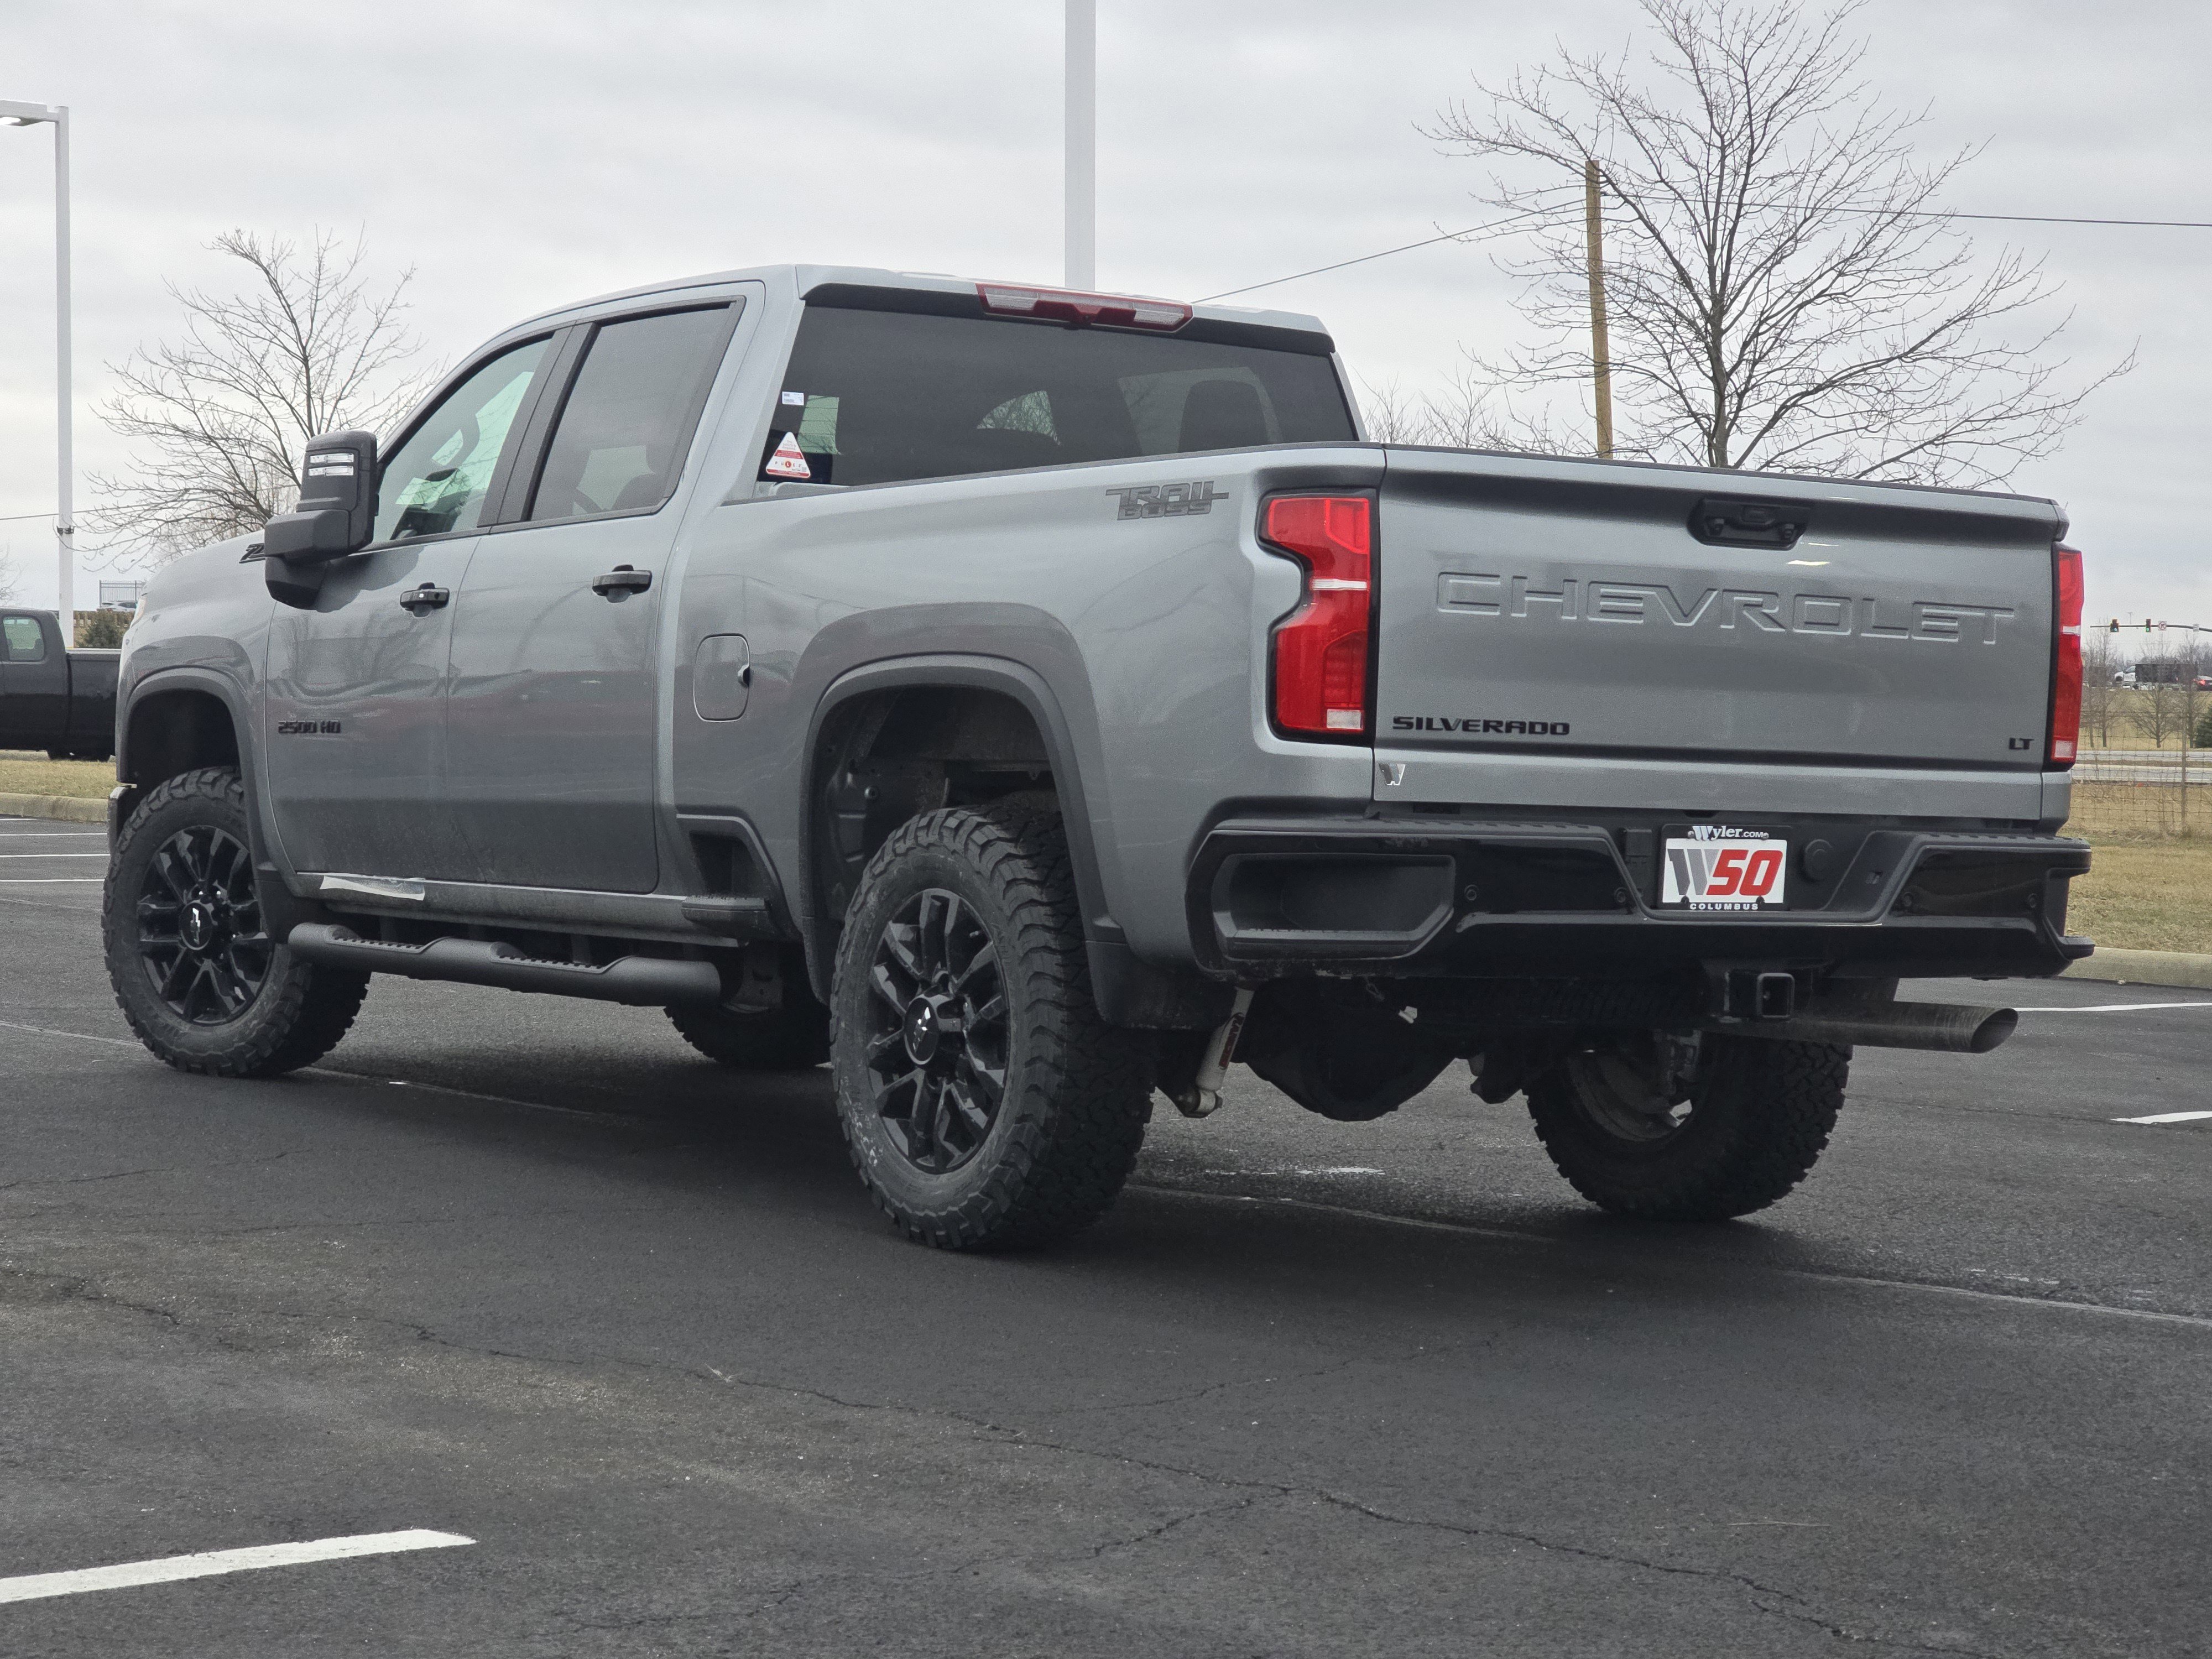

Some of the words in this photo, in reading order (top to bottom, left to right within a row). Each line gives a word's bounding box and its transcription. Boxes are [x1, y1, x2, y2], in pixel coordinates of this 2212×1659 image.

[1105, 481, 1229, 504] TRAIL
[1117, 499, 1212, 521] BOSS
[1437, 571, 2015, 645] CHEVROLET
[278, 720, 317, 734] 2500
[320, 720, 341, 733] HD
[1392, 716, 1570, 735] SILVERADO
[2009, 737, 2034, 750] LT
